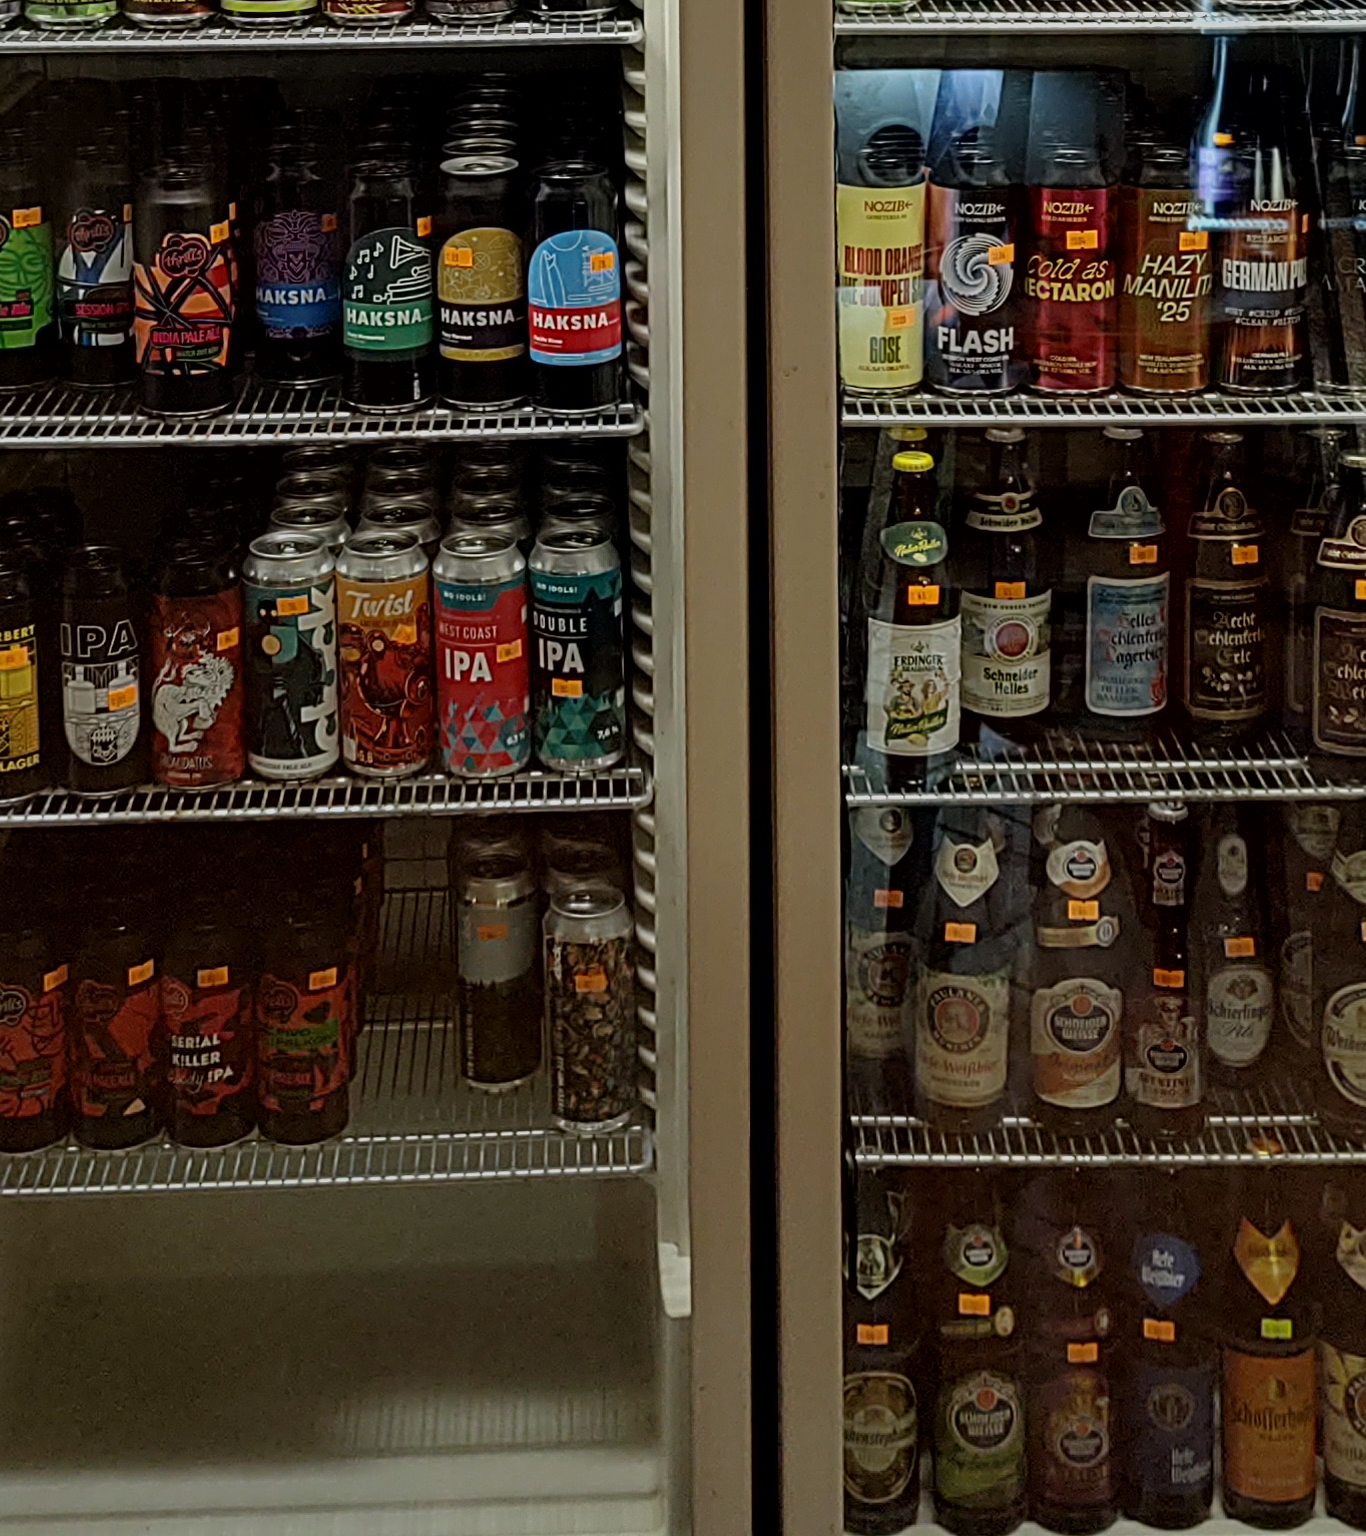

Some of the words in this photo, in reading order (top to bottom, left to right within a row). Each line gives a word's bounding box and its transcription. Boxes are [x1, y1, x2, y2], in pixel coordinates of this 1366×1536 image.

[1141, 252, 1208, 277] HAZY
[1222, 258, 1287, 293] GERMAN
[346, 309, 422, 326] HAKSNA
[440, 307, 515, 326] HAKSNA
[533, 312, 609, 330] HAKSNA
[869, 335, 902, 365] GOSE
[937, 326, 1015, 355] FLASH
[60, 619, 139, 657] IPA
[444, 648, 493, 683] IPA
[539, 637, 585, 674] IPA
[983, 666, 1038, 682] Schneider
[994, 680, 1030, 696] Helles
